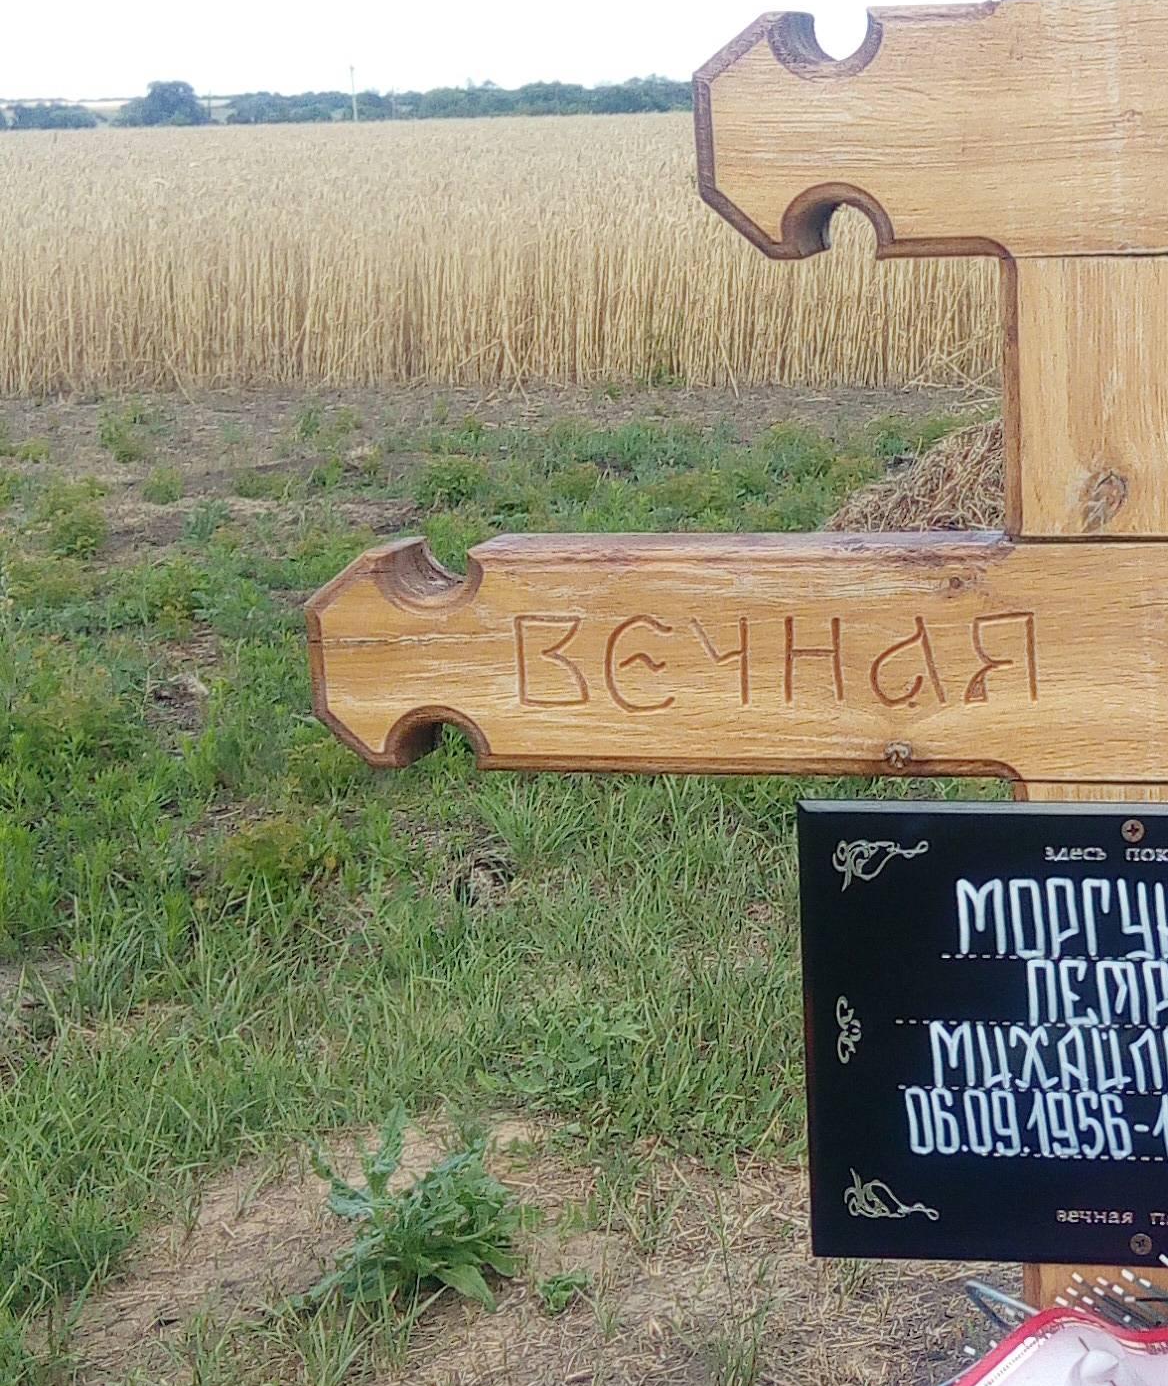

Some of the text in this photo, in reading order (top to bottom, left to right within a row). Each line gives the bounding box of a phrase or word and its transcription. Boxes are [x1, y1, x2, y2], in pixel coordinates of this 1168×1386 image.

[513, 612, 1038, 714] ВЕЧНАЯ
[1043, 845, 1108, 862] здесь
[1055, 1209, 1134, 1225] вечная
